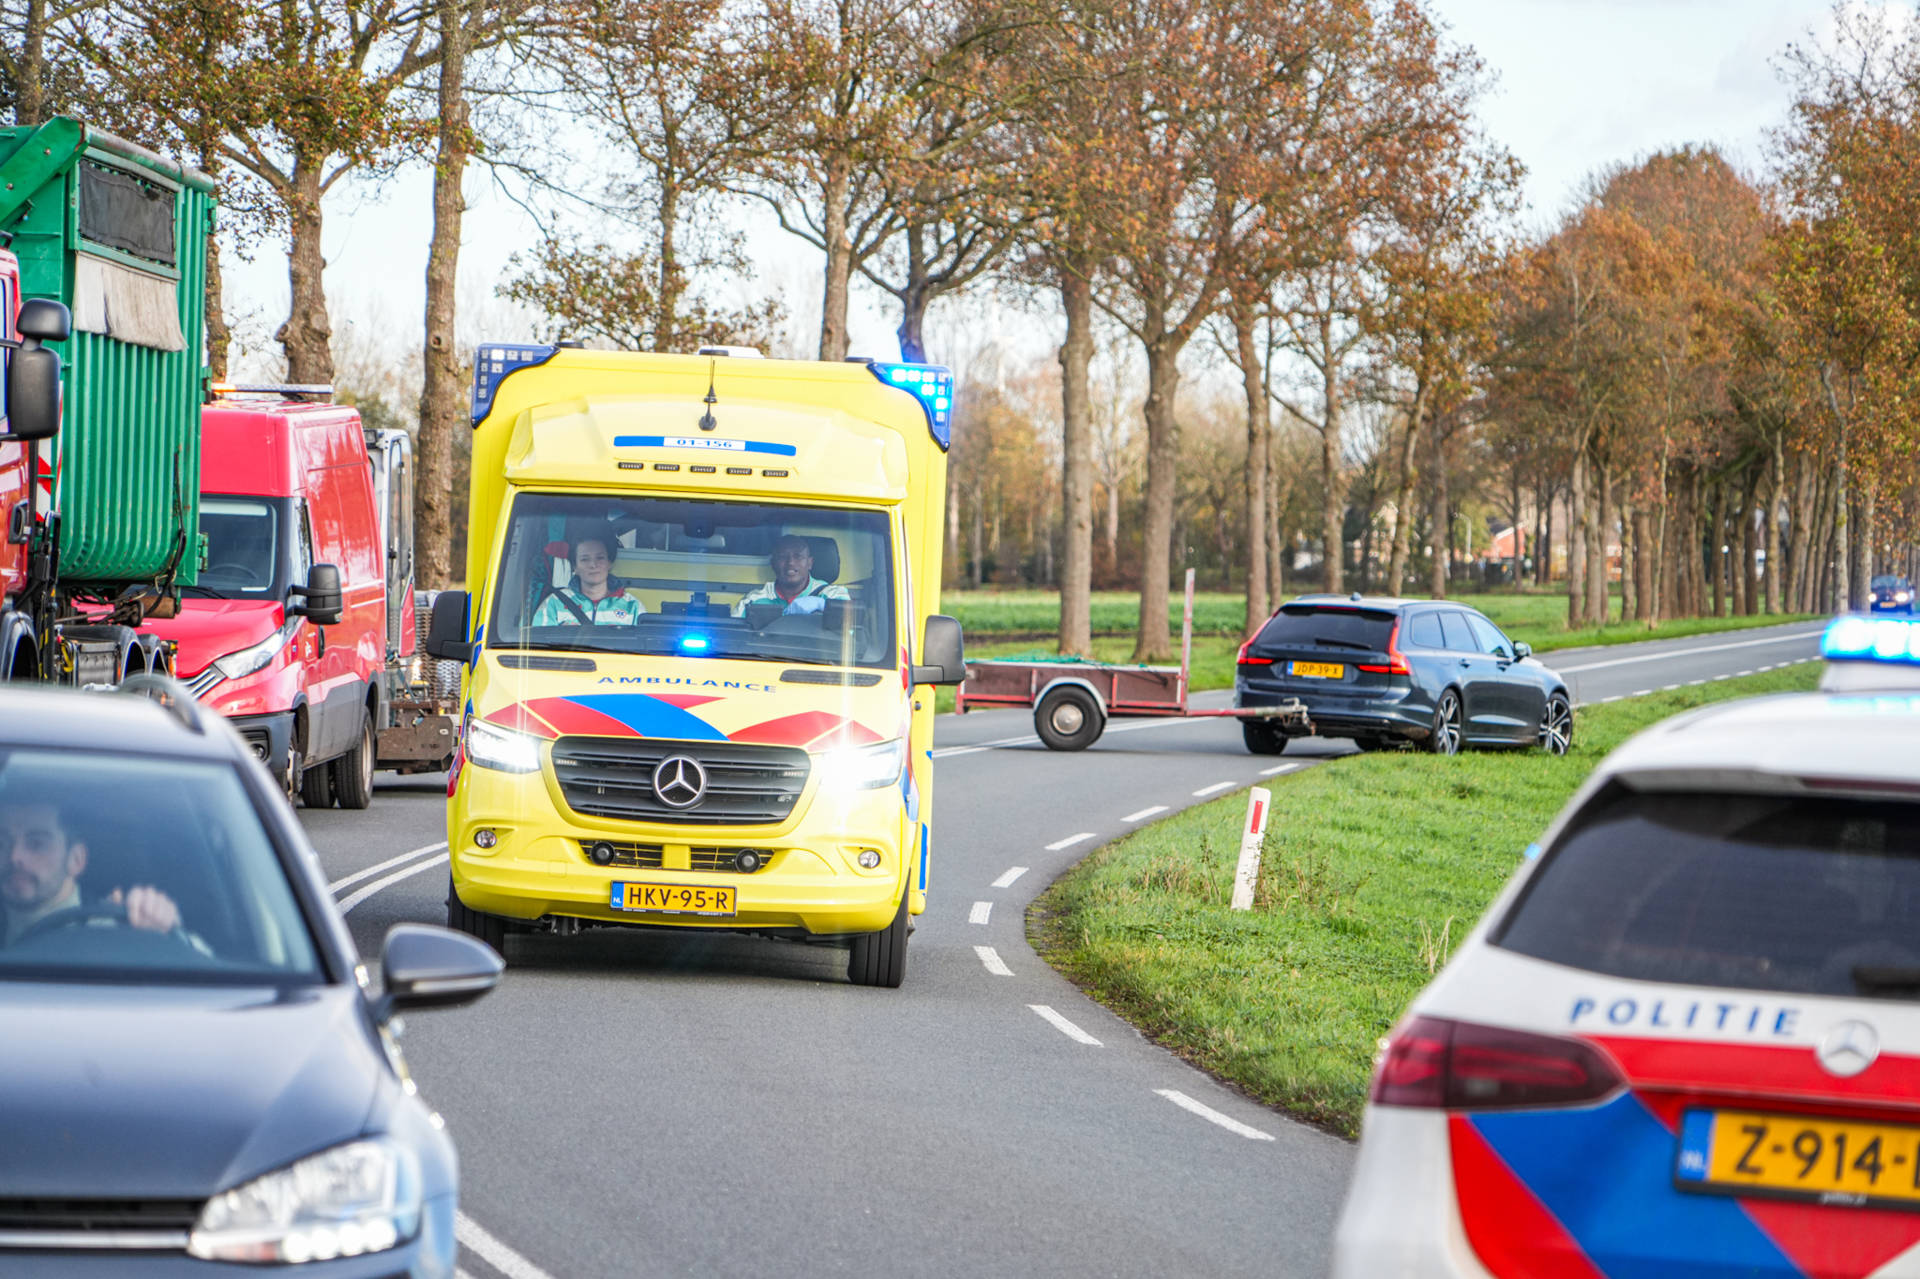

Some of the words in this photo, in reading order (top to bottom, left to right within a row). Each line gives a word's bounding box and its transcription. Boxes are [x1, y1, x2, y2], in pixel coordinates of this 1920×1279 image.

[676, 439, 732, 448] 01-156
[598, 676, 776, 693] AMBULANCE
[629, 887, 728, 909] HKV-95-R
[1568, 999, 1802, 1036] POLITIE
[1735, 1124, 1920, 1190] Z-914-
